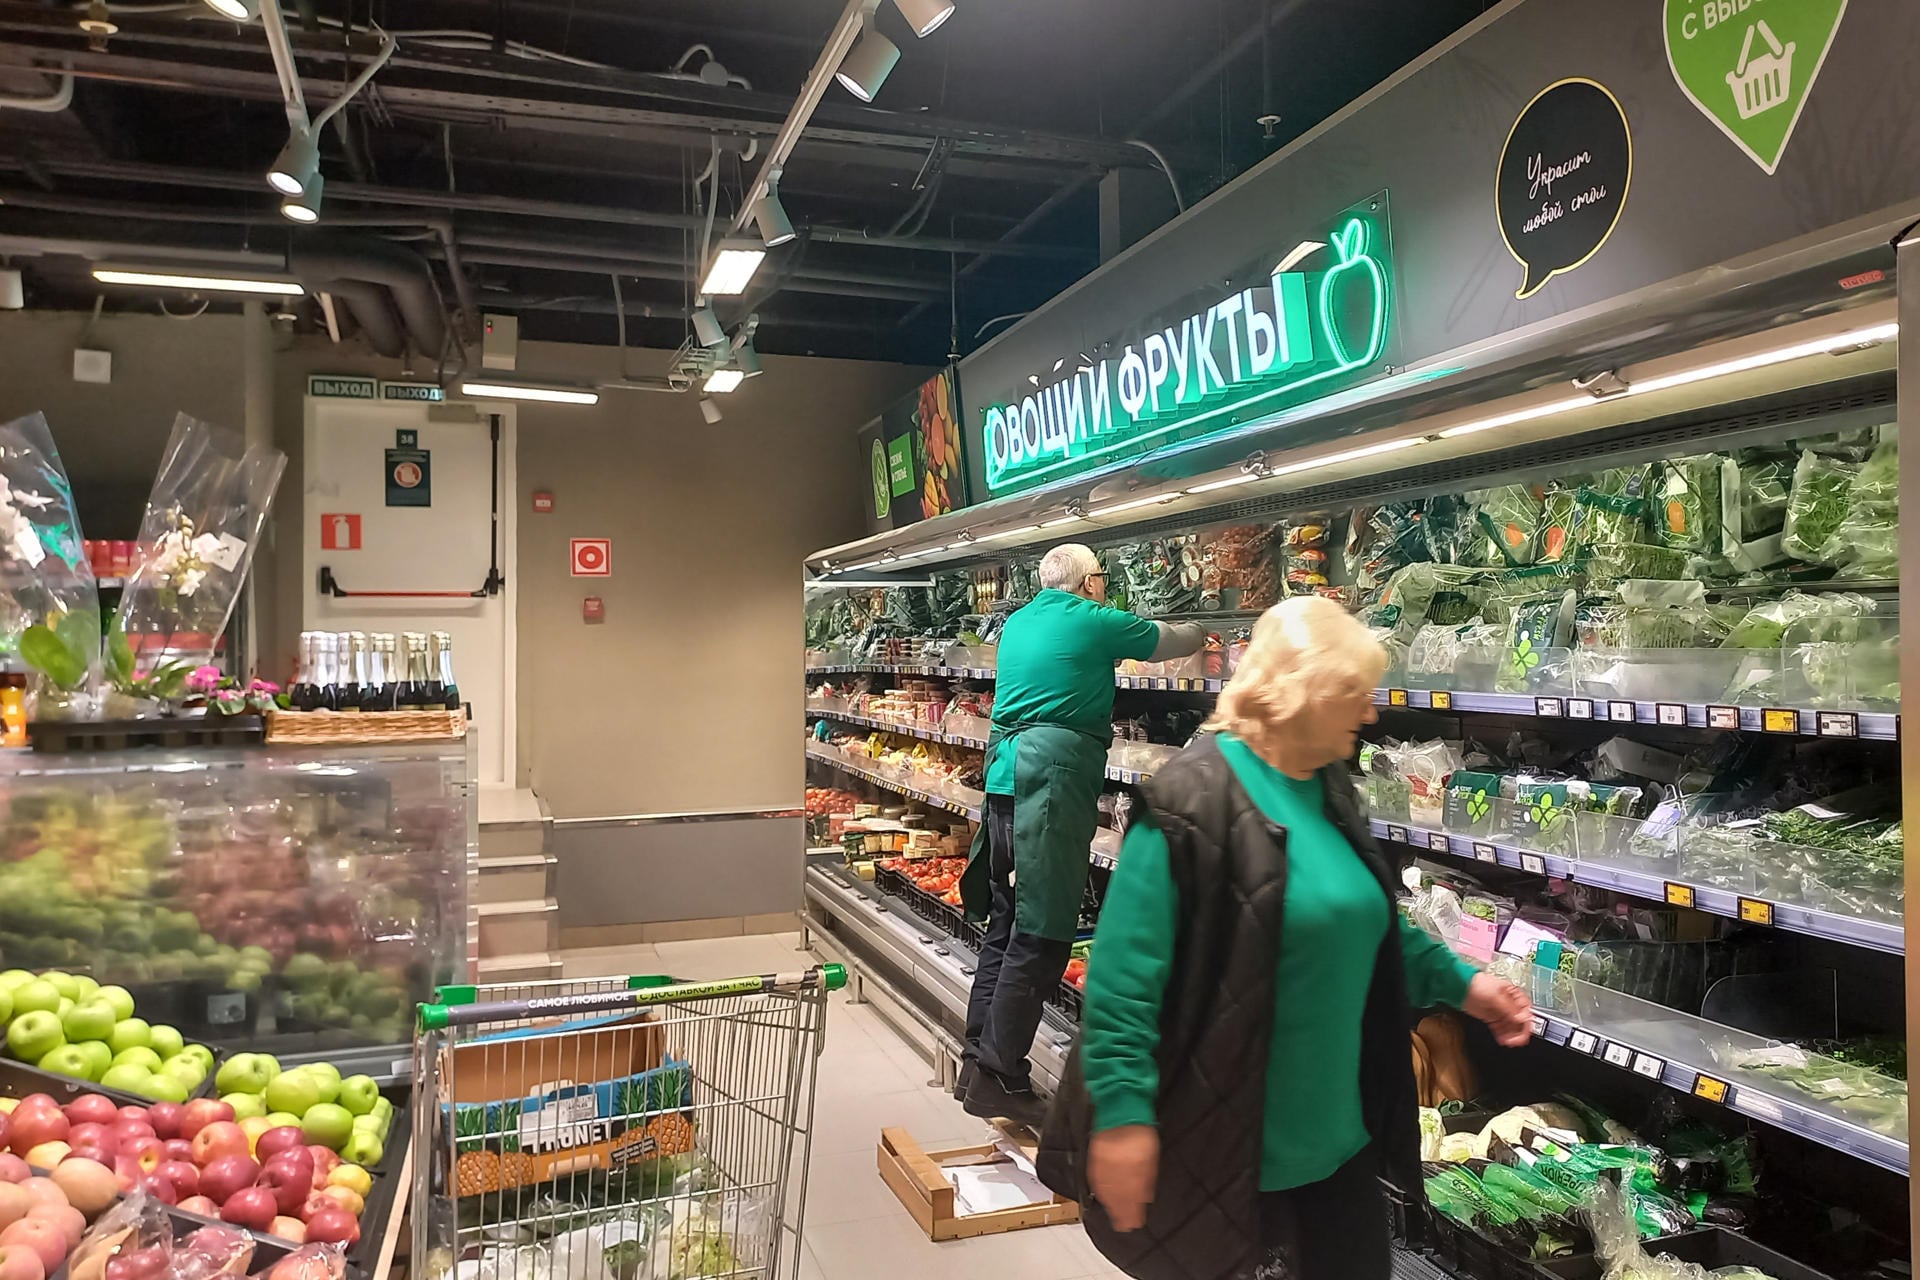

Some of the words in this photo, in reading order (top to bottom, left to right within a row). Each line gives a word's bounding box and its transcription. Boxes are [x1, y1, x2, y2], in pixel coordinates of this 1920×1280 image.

[1682, 13, 1698, 39] С
[1527, 151, 1592, 200] Украсит
[1522, 201, 1564, 234] любой
[1571, 184, 1607, 212] стол
[989, 372, 1088, 468] ОВОЩИ
[1087, 359, 1113, 435] И
[1116, 271, 1292, 422] ФРУКТЫ
[313, 381, 373, 397] ВЫХОД
[386, 387, 441, 400] ВЫХОД
[527, 996, 570, 1009] САМОЕ
[570, 991, 630, 1005] ЛЮБИМОЕ
